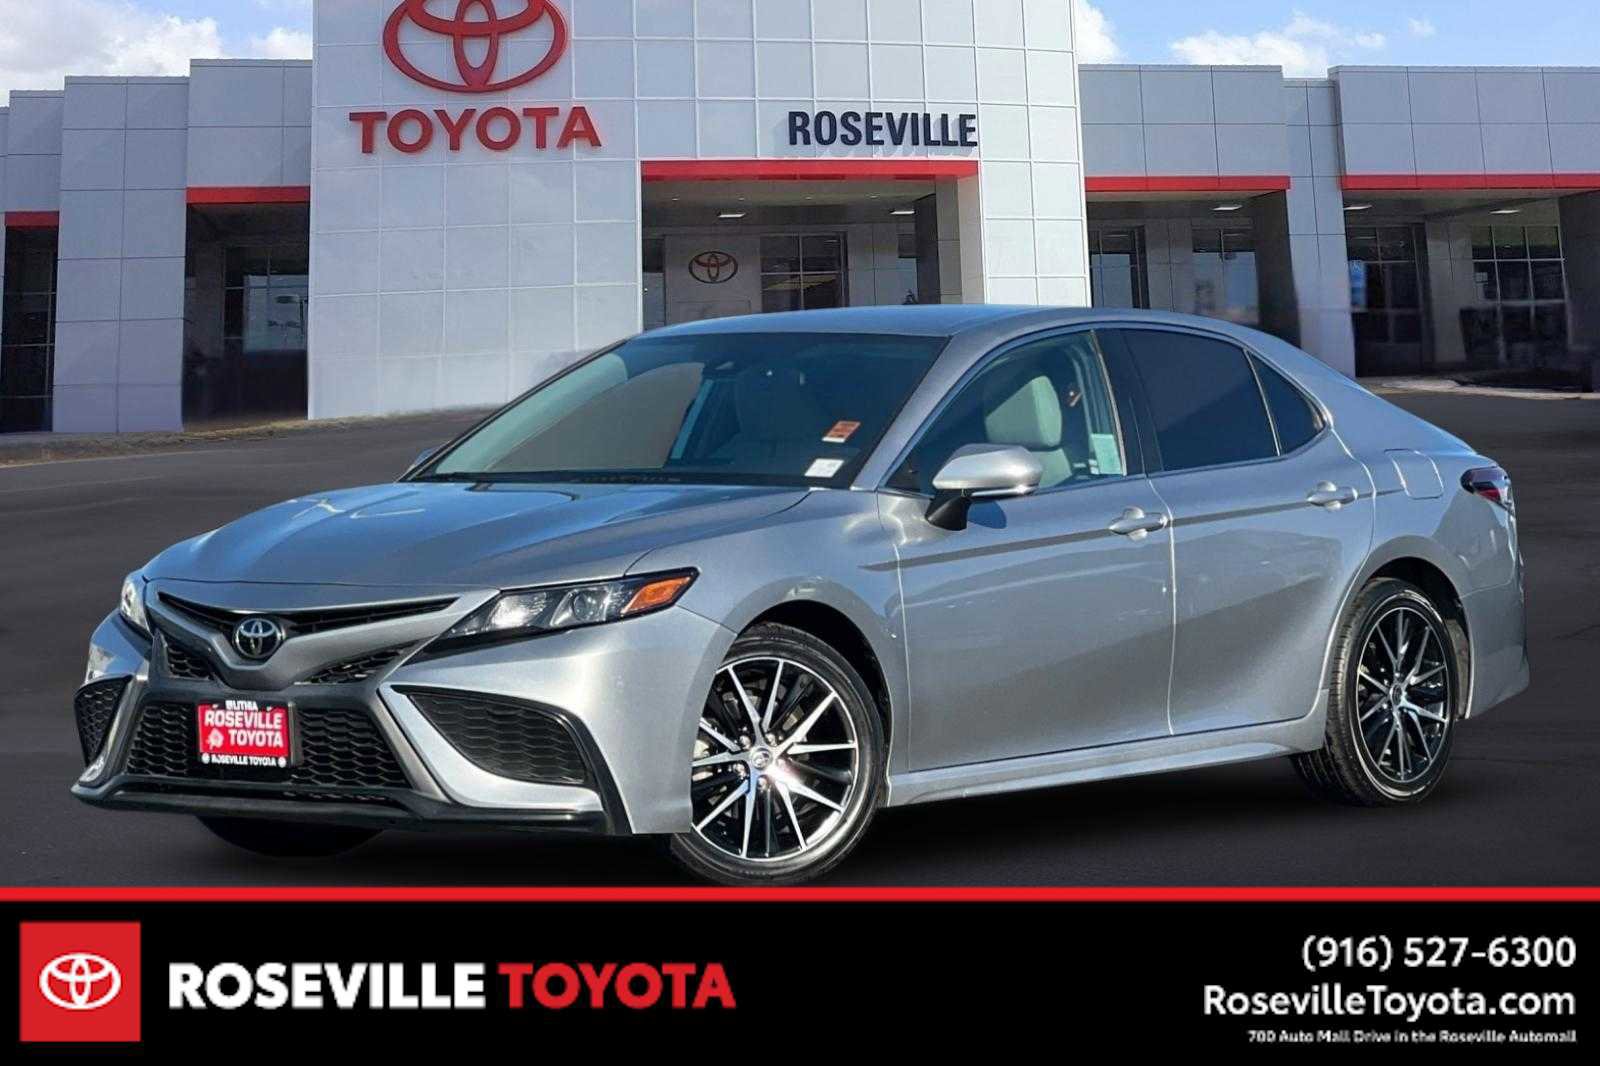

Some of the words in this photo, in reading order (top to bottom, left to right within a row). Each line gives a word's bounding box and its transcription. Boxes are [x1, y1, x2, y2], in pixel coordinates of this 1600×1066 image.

[349, 106, 602, 154] TOYOTA
[788, 111, 978, 147] ROSEVILLE
[204, 709, 283, 729] ROSEVILLE
[228, 729, 284, 747] TOYOTA
